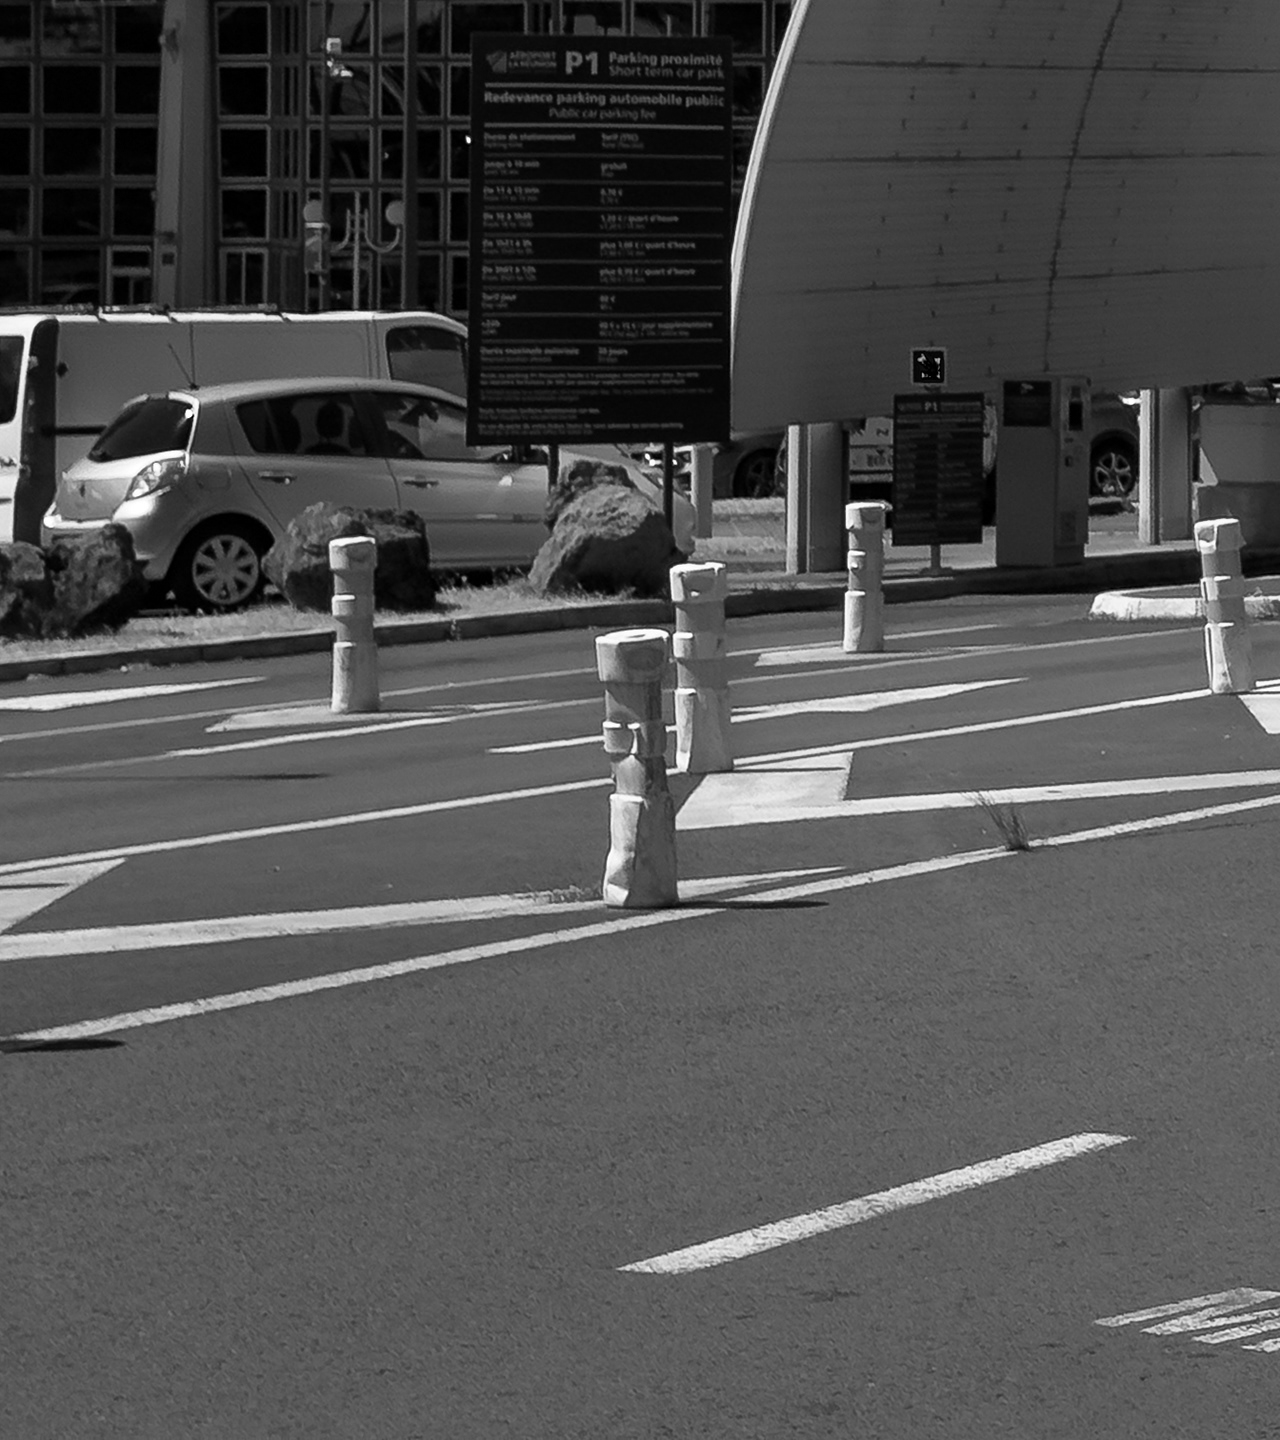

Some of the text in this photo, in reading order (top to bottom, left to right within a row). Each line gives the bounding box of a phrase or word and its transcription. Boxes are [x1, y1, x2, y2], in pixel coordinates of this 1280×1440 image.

[565, 50, 598, 75] P1
[608, 51, 724, 67] Parking proximité
[608, 64, 725, 81] Short term car park
[484, 90, 725, 108] Redevance parking automobile public
